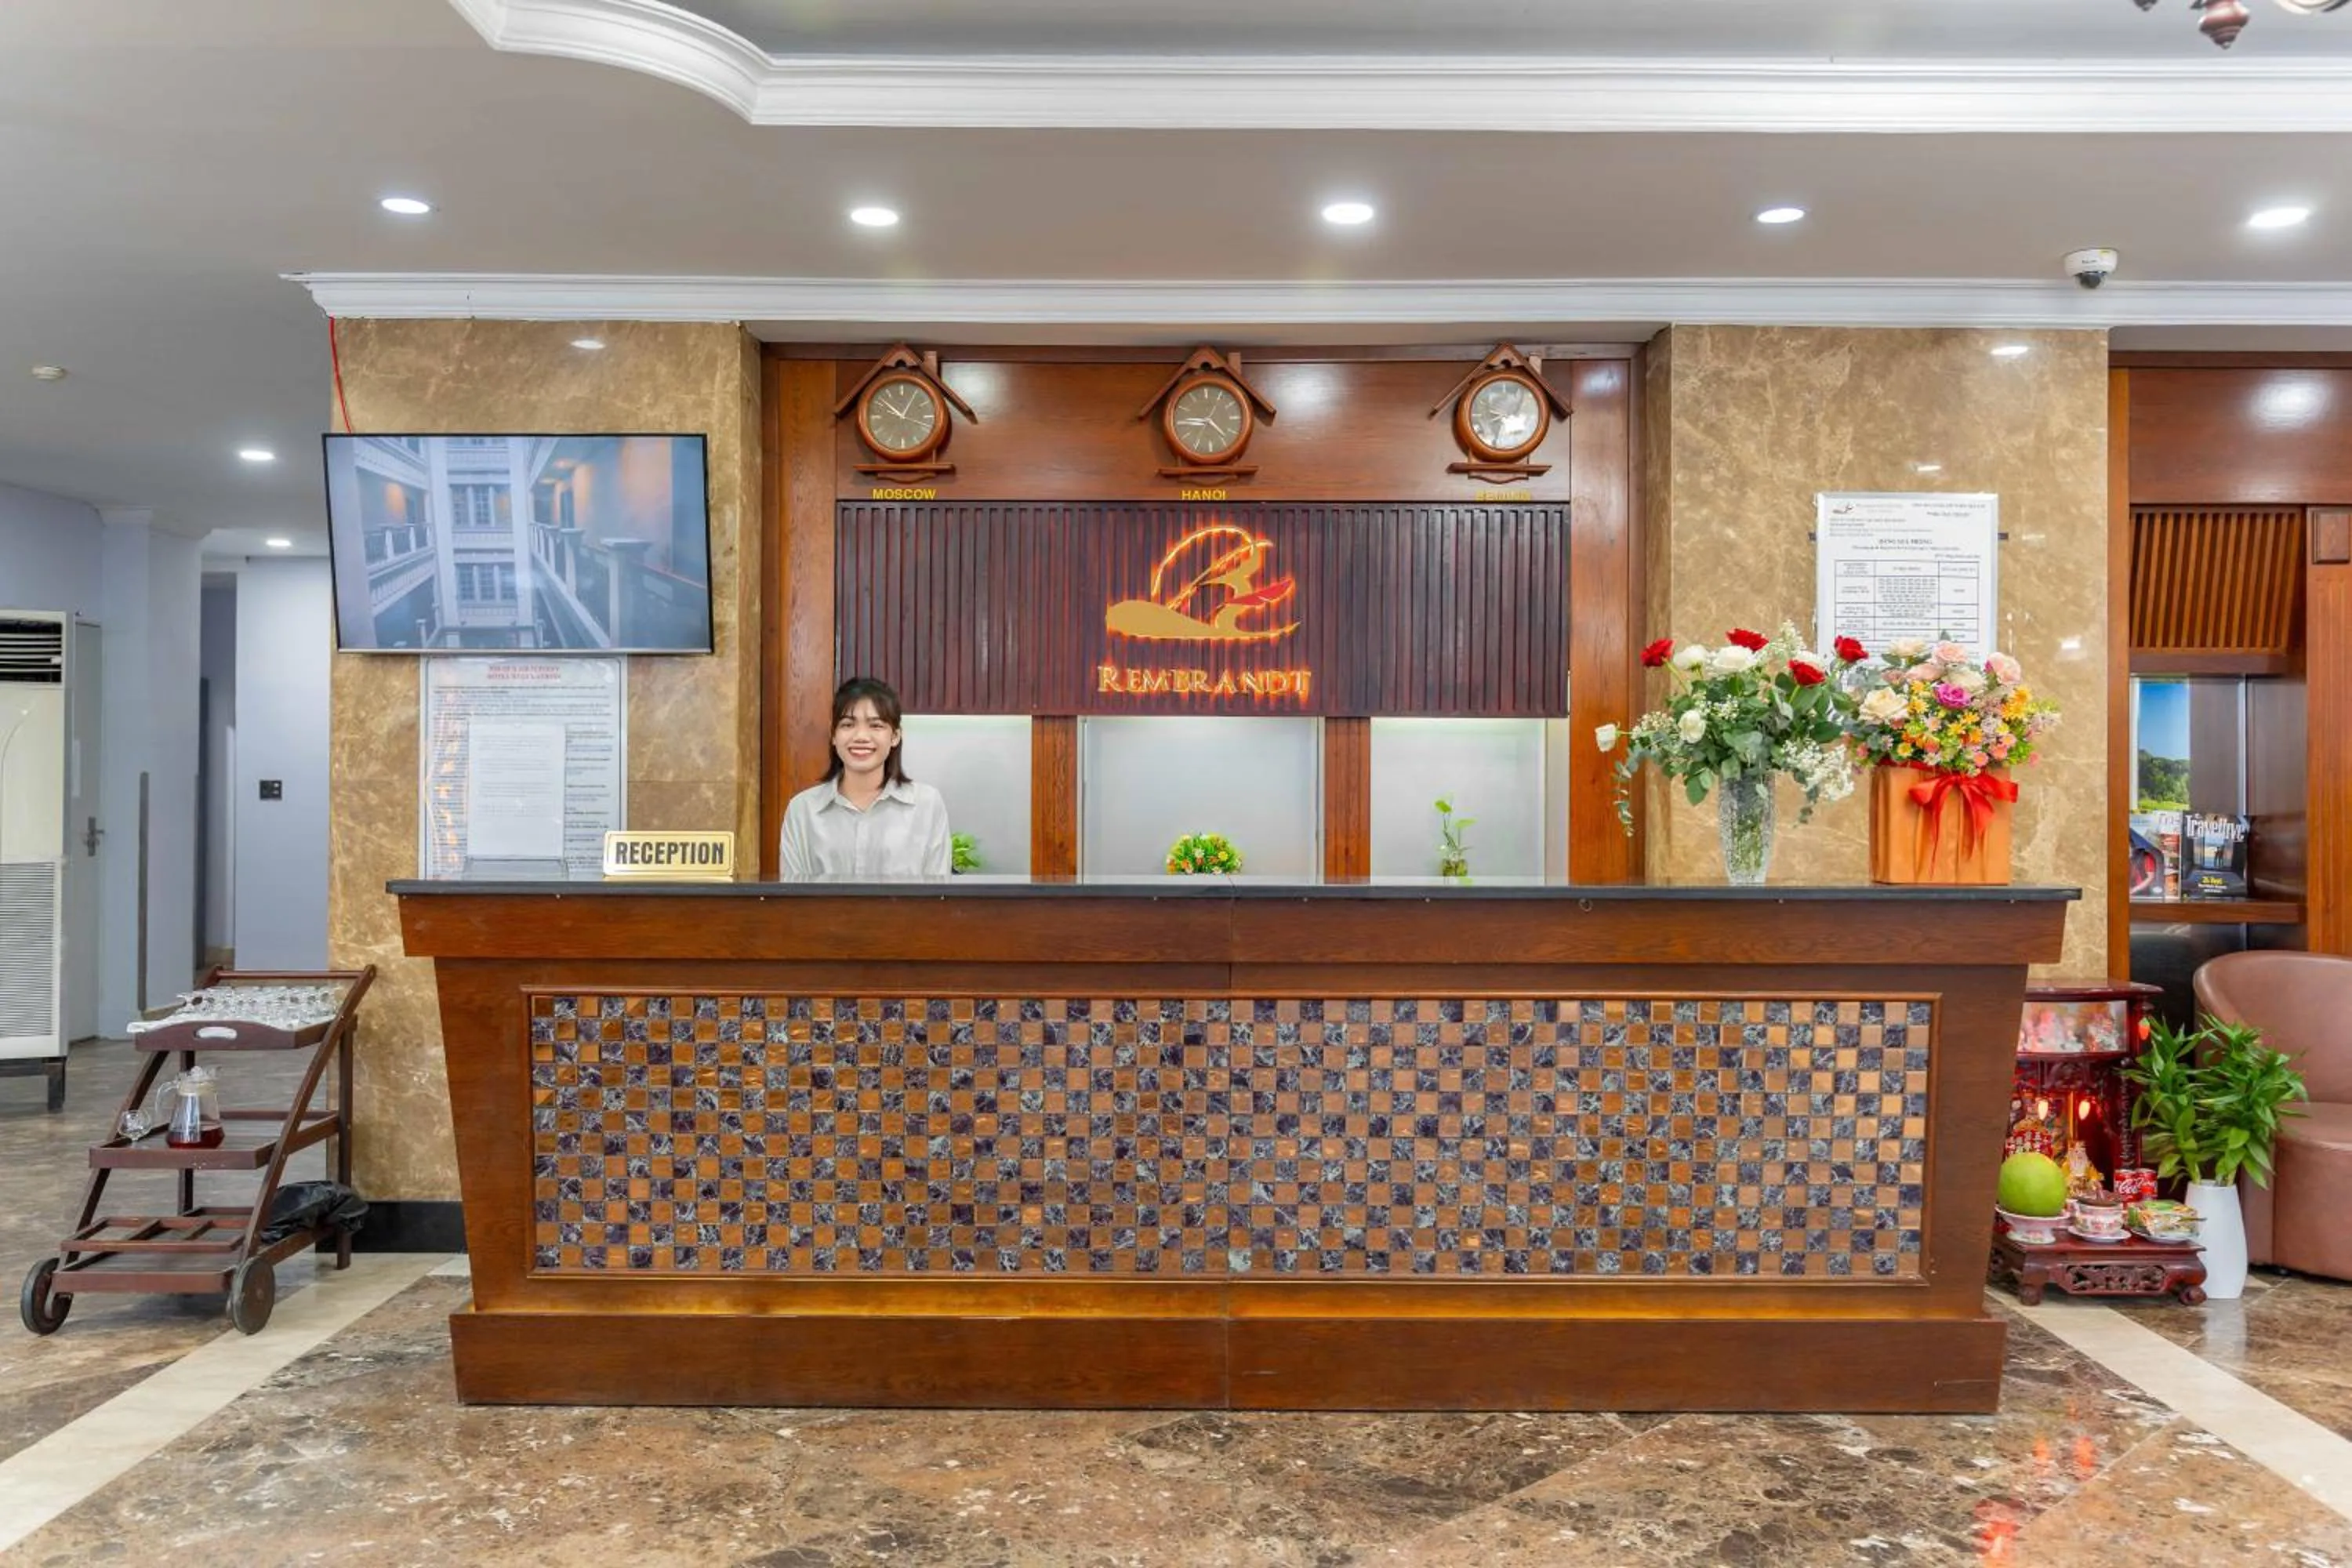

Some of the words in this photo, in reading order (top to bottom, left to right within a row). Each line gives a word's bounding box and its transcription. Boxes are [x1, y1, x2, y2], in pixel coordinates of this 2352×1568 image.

[872, 488, 936, 499] MOSCOW
[1181, 490, 1226, 500] HANOI
[1097, 666, 1312, 694] REMBRANDT
[615, 841, 724, 865] RECEPTION
